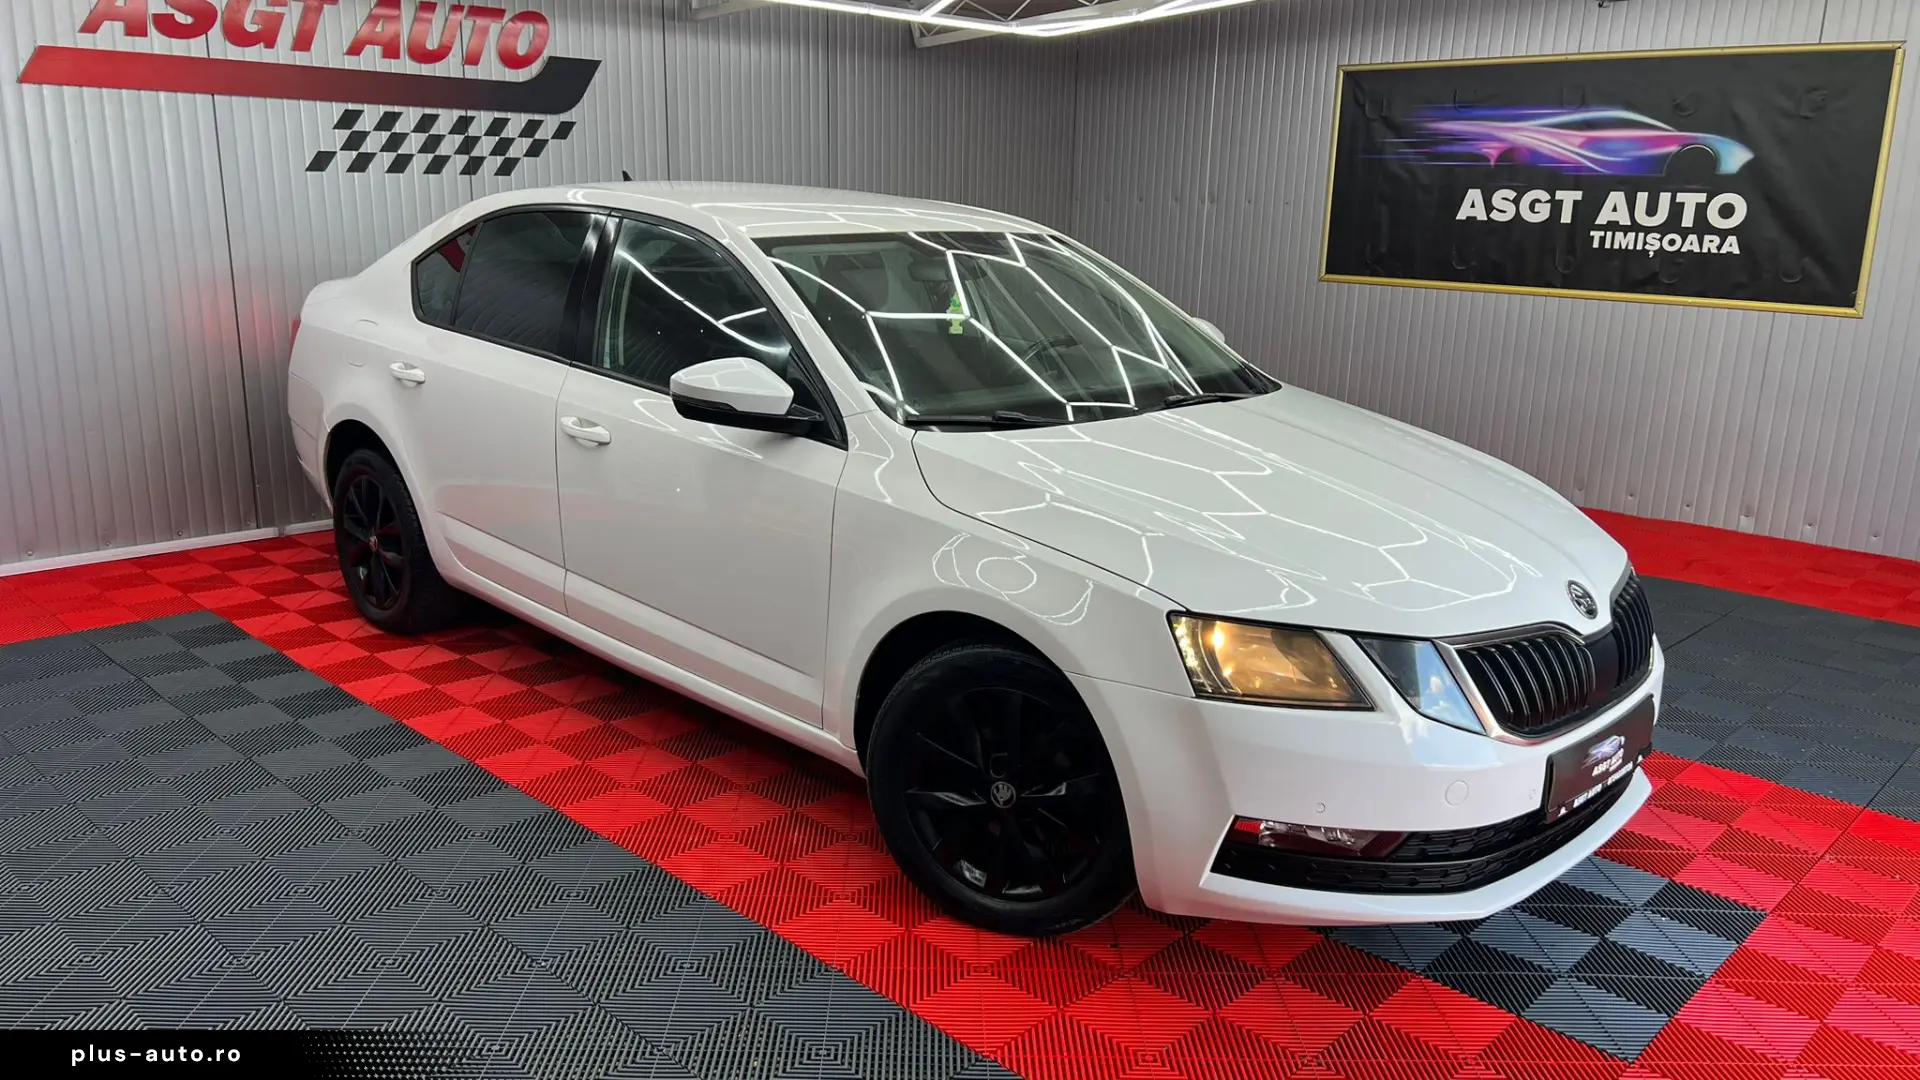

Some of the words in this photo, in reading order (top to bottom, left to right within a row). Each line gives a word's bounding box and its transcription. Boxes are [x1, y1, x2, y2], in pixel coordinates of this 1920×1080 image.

[77, 0, 338, 53] ASGT
[345, 2, 550, 70] AUTO
[1455, 188, 1583, 224] ASGT
[1594, 191, 1748, 229] AUTO
[1589, 230, 1741, 257] TIMIȘOARA
